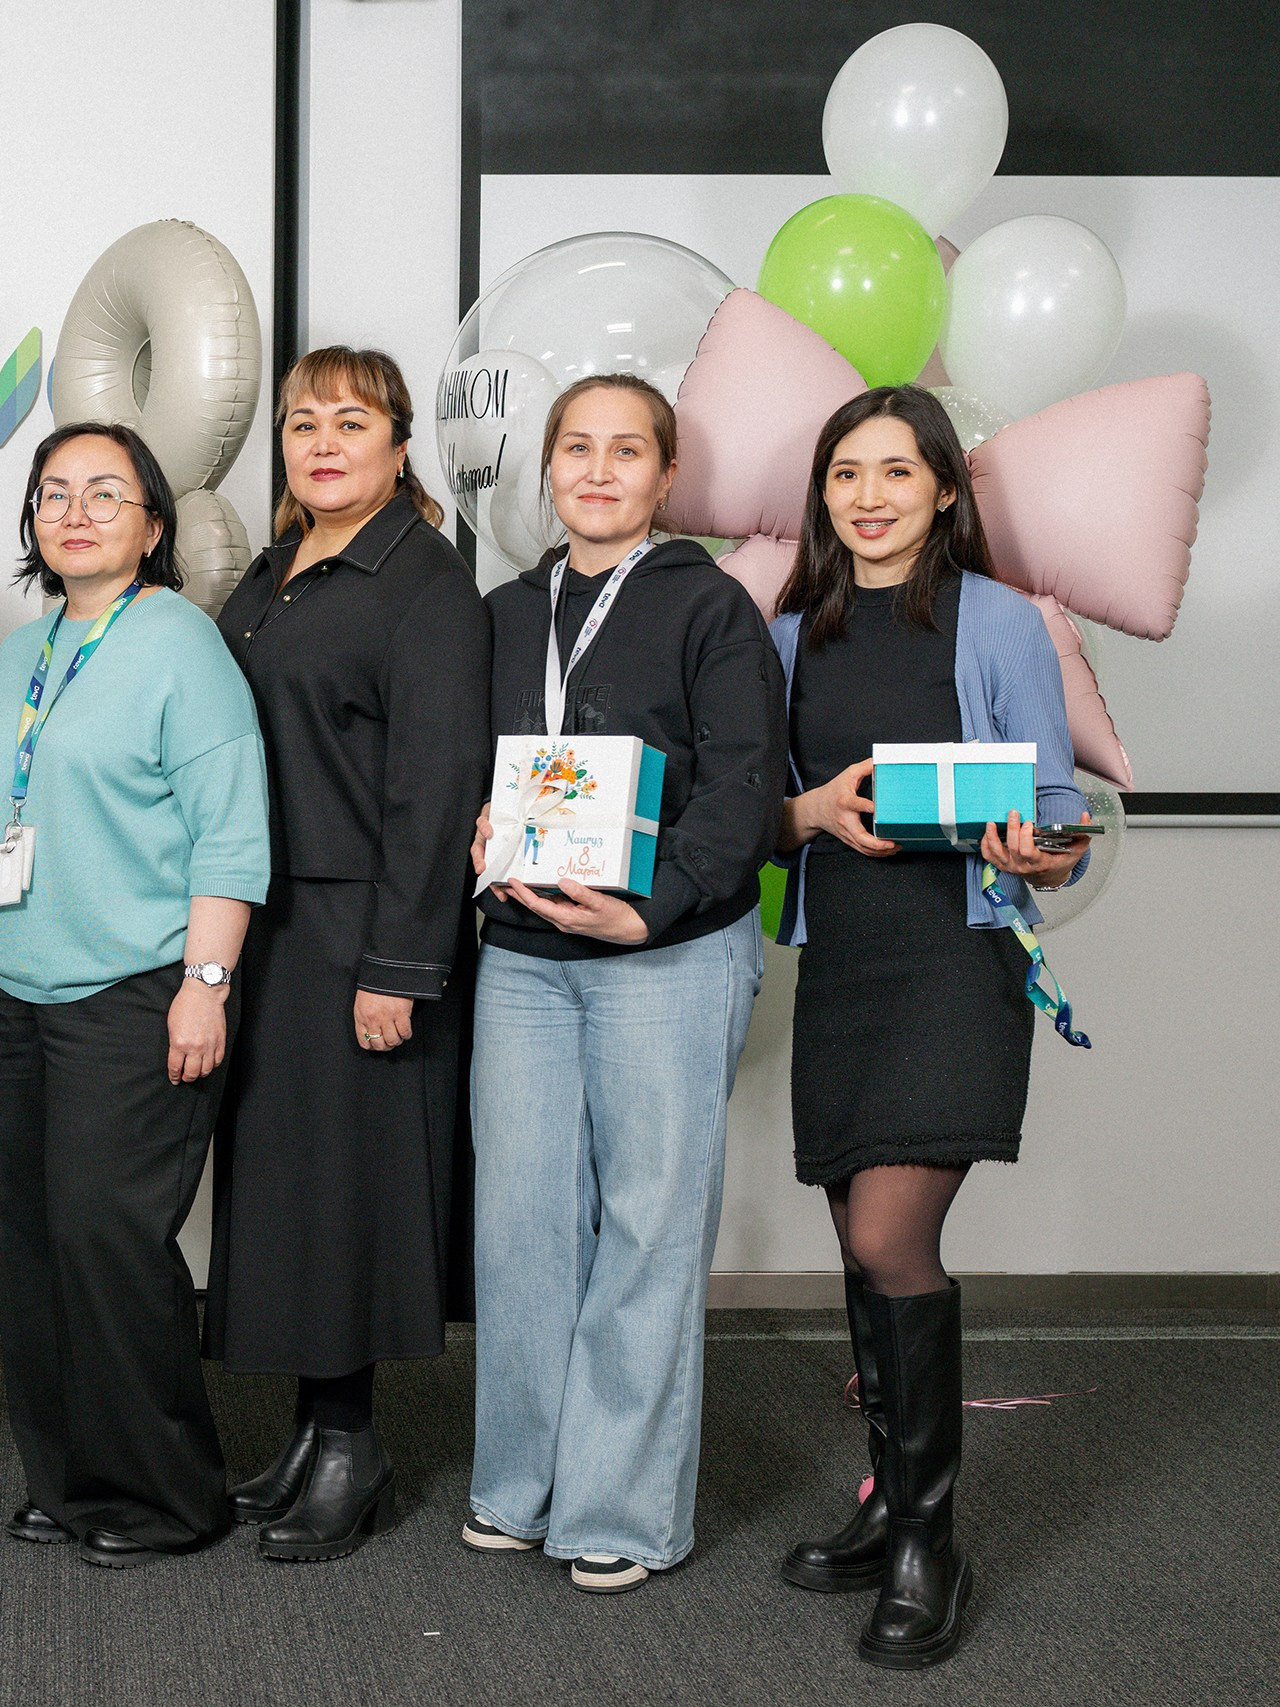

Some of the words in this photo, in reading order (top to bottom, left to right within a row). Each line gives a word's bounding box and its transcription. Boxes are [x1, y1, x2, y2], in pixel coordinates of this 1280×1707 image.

[113, 597, 128, 612] teva
[598, 592, 612, 609] teva
[73, 654, 86, 671] teva
[30, 685, 40, 701] teva
[21, 753, 31, 772] teva
[563, 829, 604, 849] Nauryz
[578, 846, 590, 866] 8
[986, 886, 1002, 904] teva
[1012, 917, 1027, 935] teva
